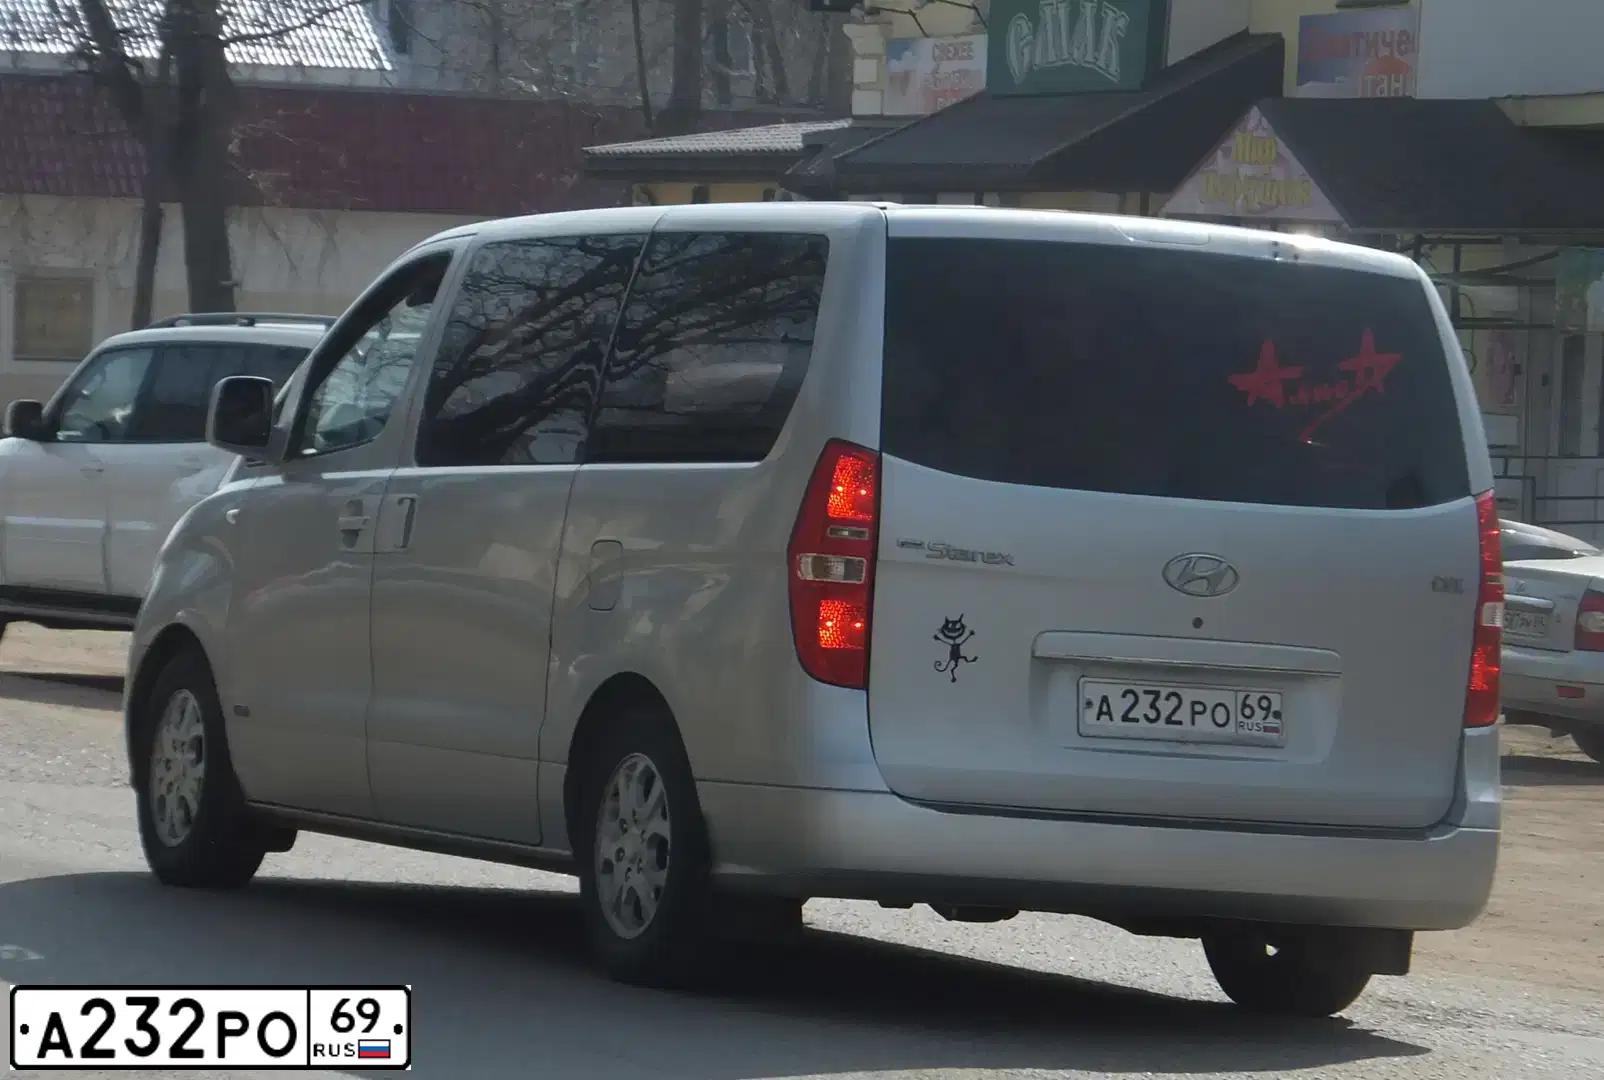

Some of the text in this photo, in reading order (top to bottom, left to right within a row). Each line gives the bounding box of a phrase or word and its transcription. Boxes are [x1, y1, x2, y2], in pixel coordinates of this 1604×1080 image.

[925, 539, 1015, 567] Starex
[1240, 693, 1273, 721] 69
[1237, 720, 1262, 732] RUS
